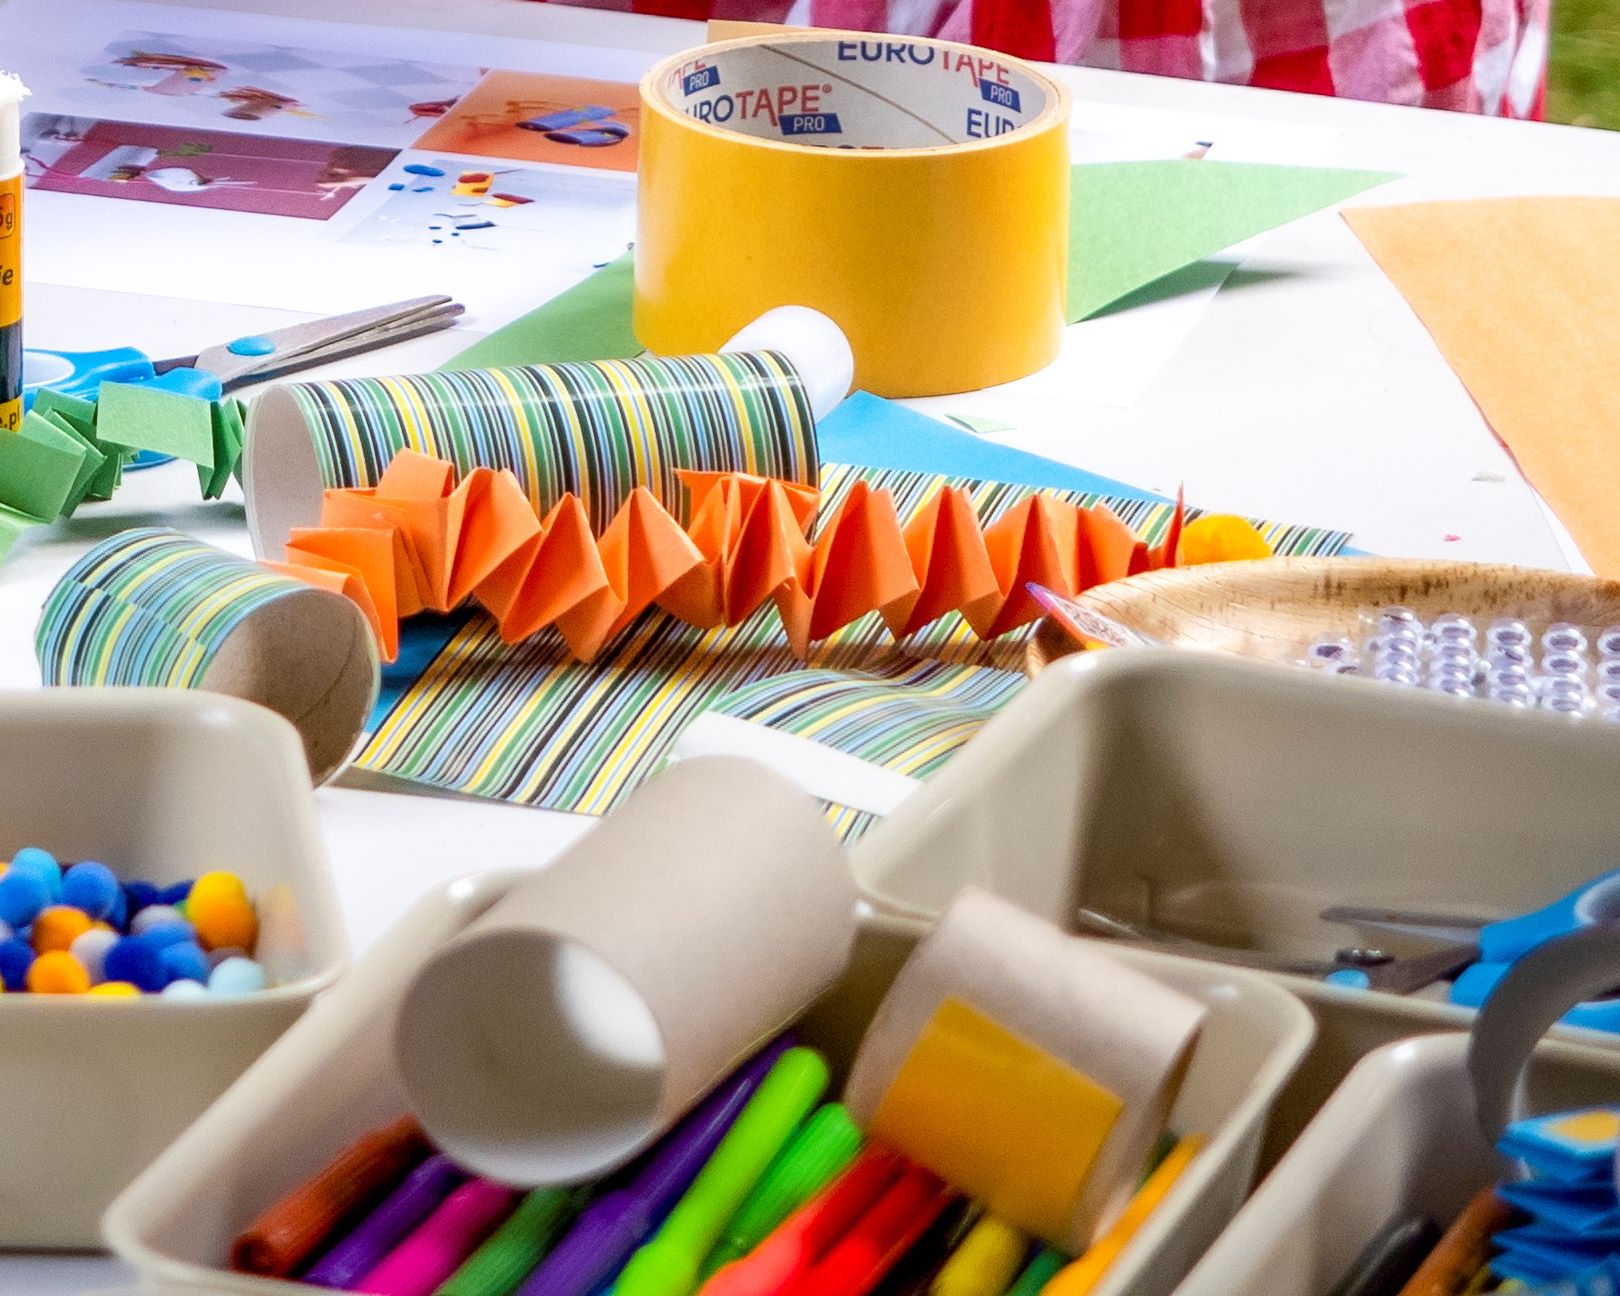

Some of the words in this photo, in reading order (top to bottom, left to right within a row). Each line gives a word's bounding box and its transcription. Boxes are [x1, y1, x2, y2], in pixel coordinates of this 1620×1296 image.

[689, 71, 709, 91] PRO
[990, 85, 1012, 105] PRO
[793, 116, 825, 132] PRO
